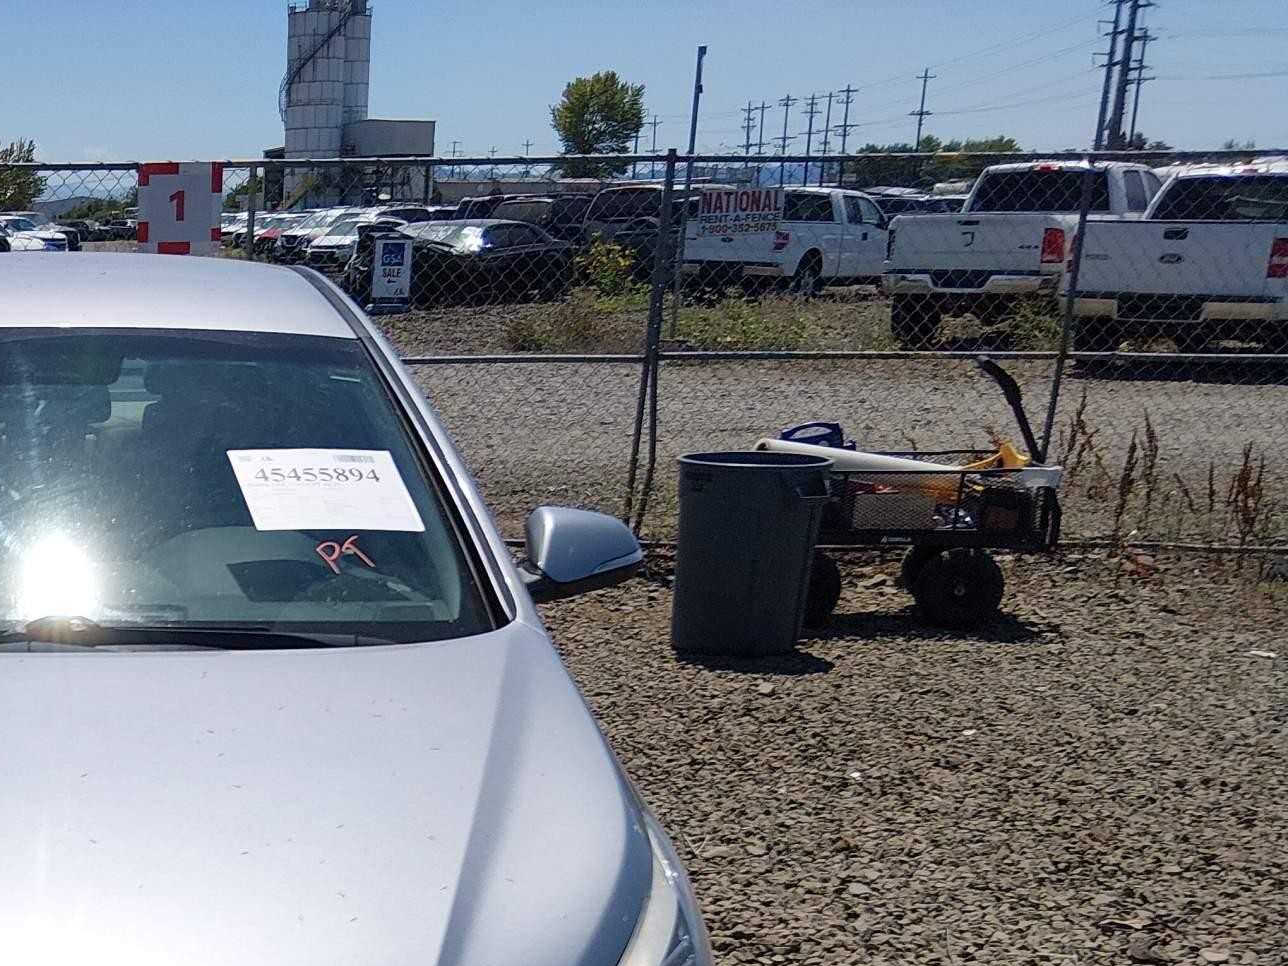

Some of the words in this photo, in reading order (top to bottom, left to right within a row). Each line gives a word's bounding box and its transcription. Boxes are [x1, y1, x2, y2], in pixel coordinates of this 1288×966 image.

[169, 190, 185, 222] 1
[701, 189, 782, 214] NATIONAL
[700, 212, 782, 225] RENT-A-FENCE
[382, 267, 401, 278] SALE
[253, 466, 380, 483] 45455894
